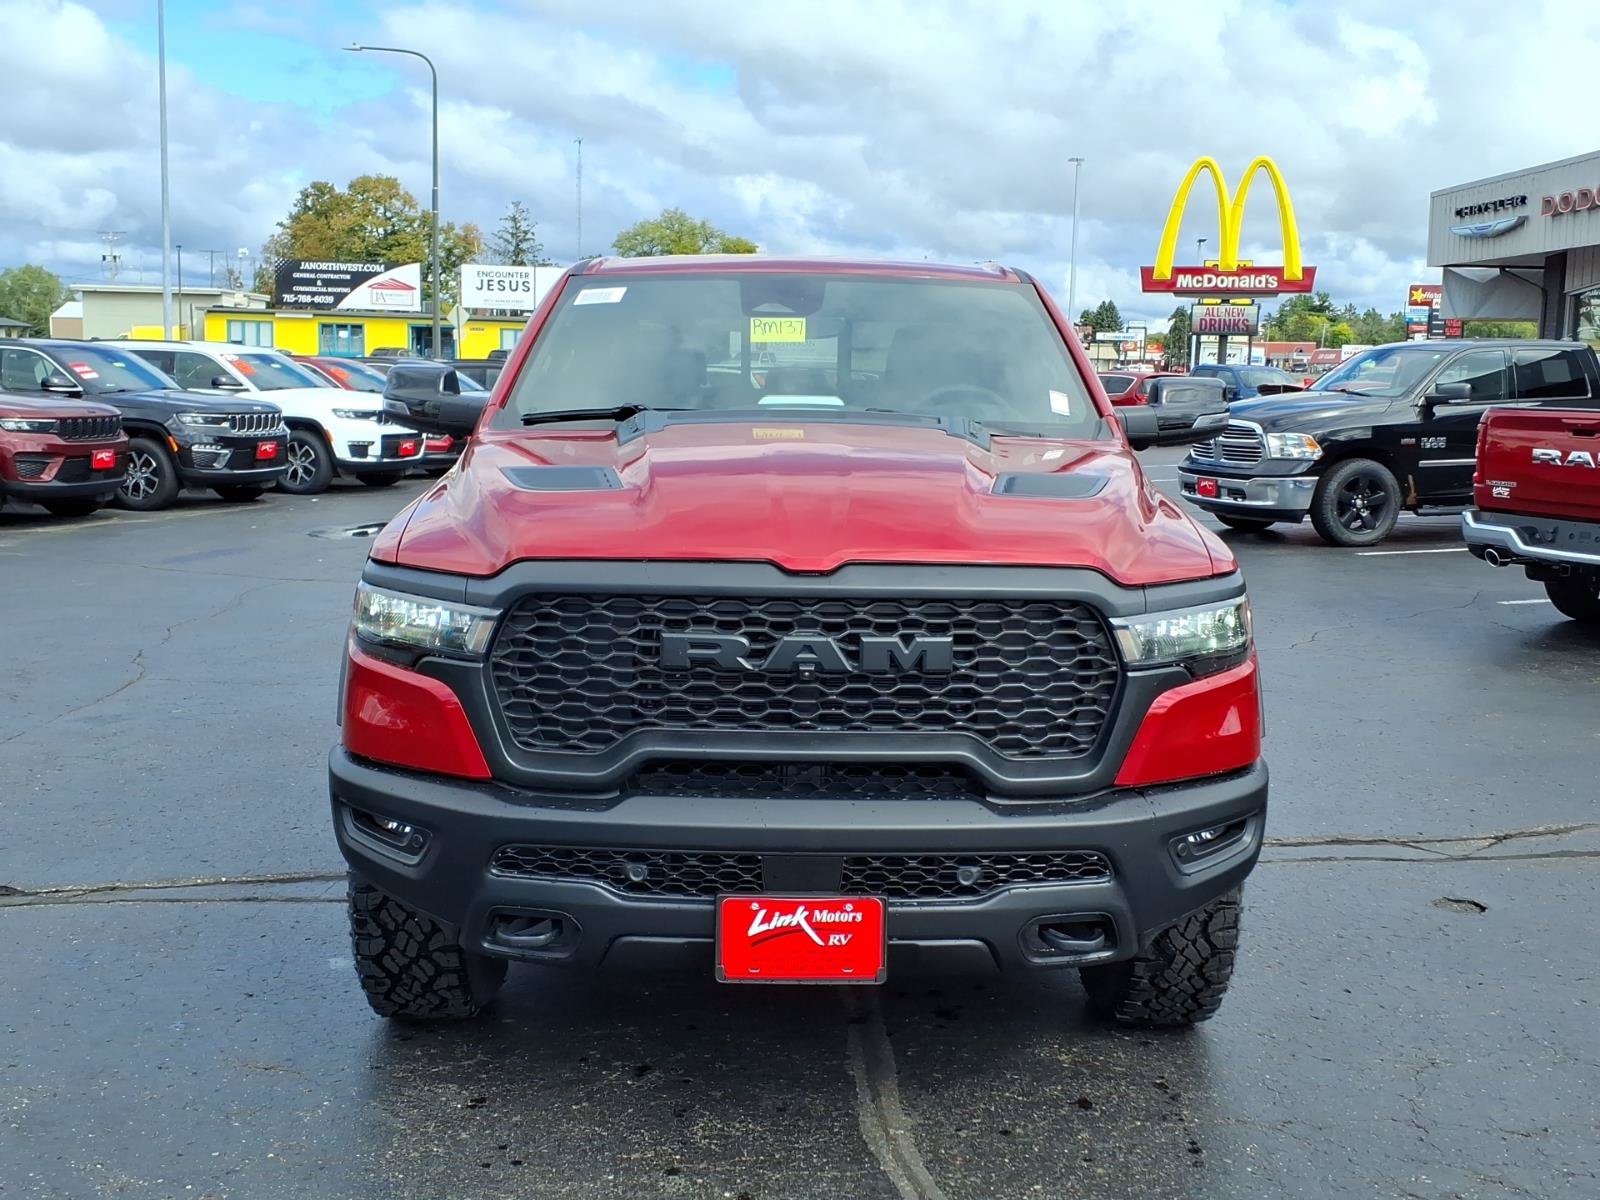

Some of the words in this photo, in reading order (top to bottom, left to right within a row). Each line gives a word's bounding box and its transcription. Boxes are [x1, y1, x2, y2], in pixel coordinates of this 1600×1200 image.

[1455, 195, 1527, 217] CHRYSLER
[300, 261, 385, 272] JANORTHWEST.COM
[476, 279, 530, 292] JESUS
[1176, 274, 1278, 288] McDonald's
[282, 294, 334, 304] 715-768-6039
[1204, 307, 1246, 318] ALL-NEW
[1198, 318, 1249, 332] DRINKS
[660, 632, 954, 672] RAM
[748, 906, 824, 946] Link
[812, 910, 862, 923] Motors
[828, 934, 852, 946] RV
